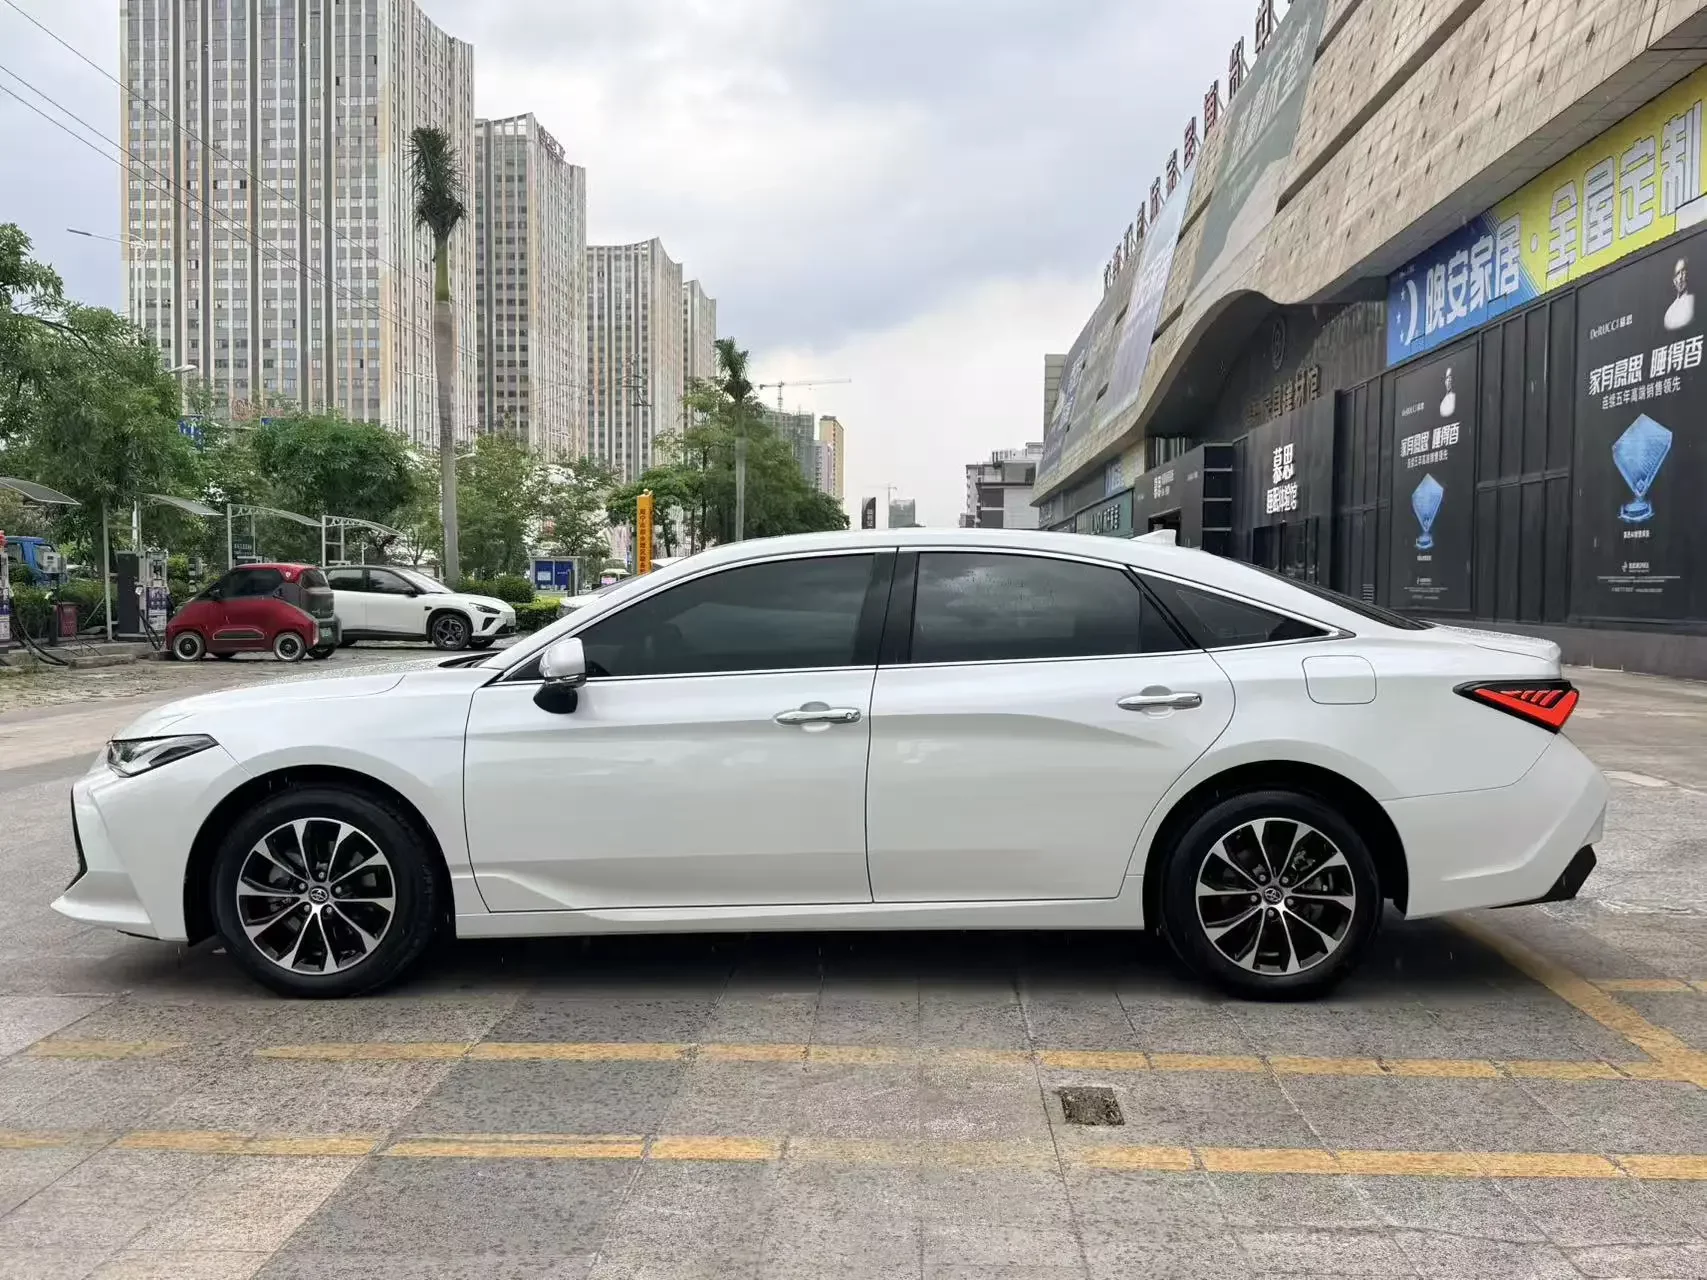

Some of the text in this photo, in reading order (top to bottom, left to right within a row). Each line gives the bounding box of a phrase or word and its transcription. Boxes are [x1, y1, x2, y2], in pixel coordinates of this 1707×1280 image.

[1650, 334, 1704, 379] 睡得香
[1272, 443, 1294, 484] 慕思
